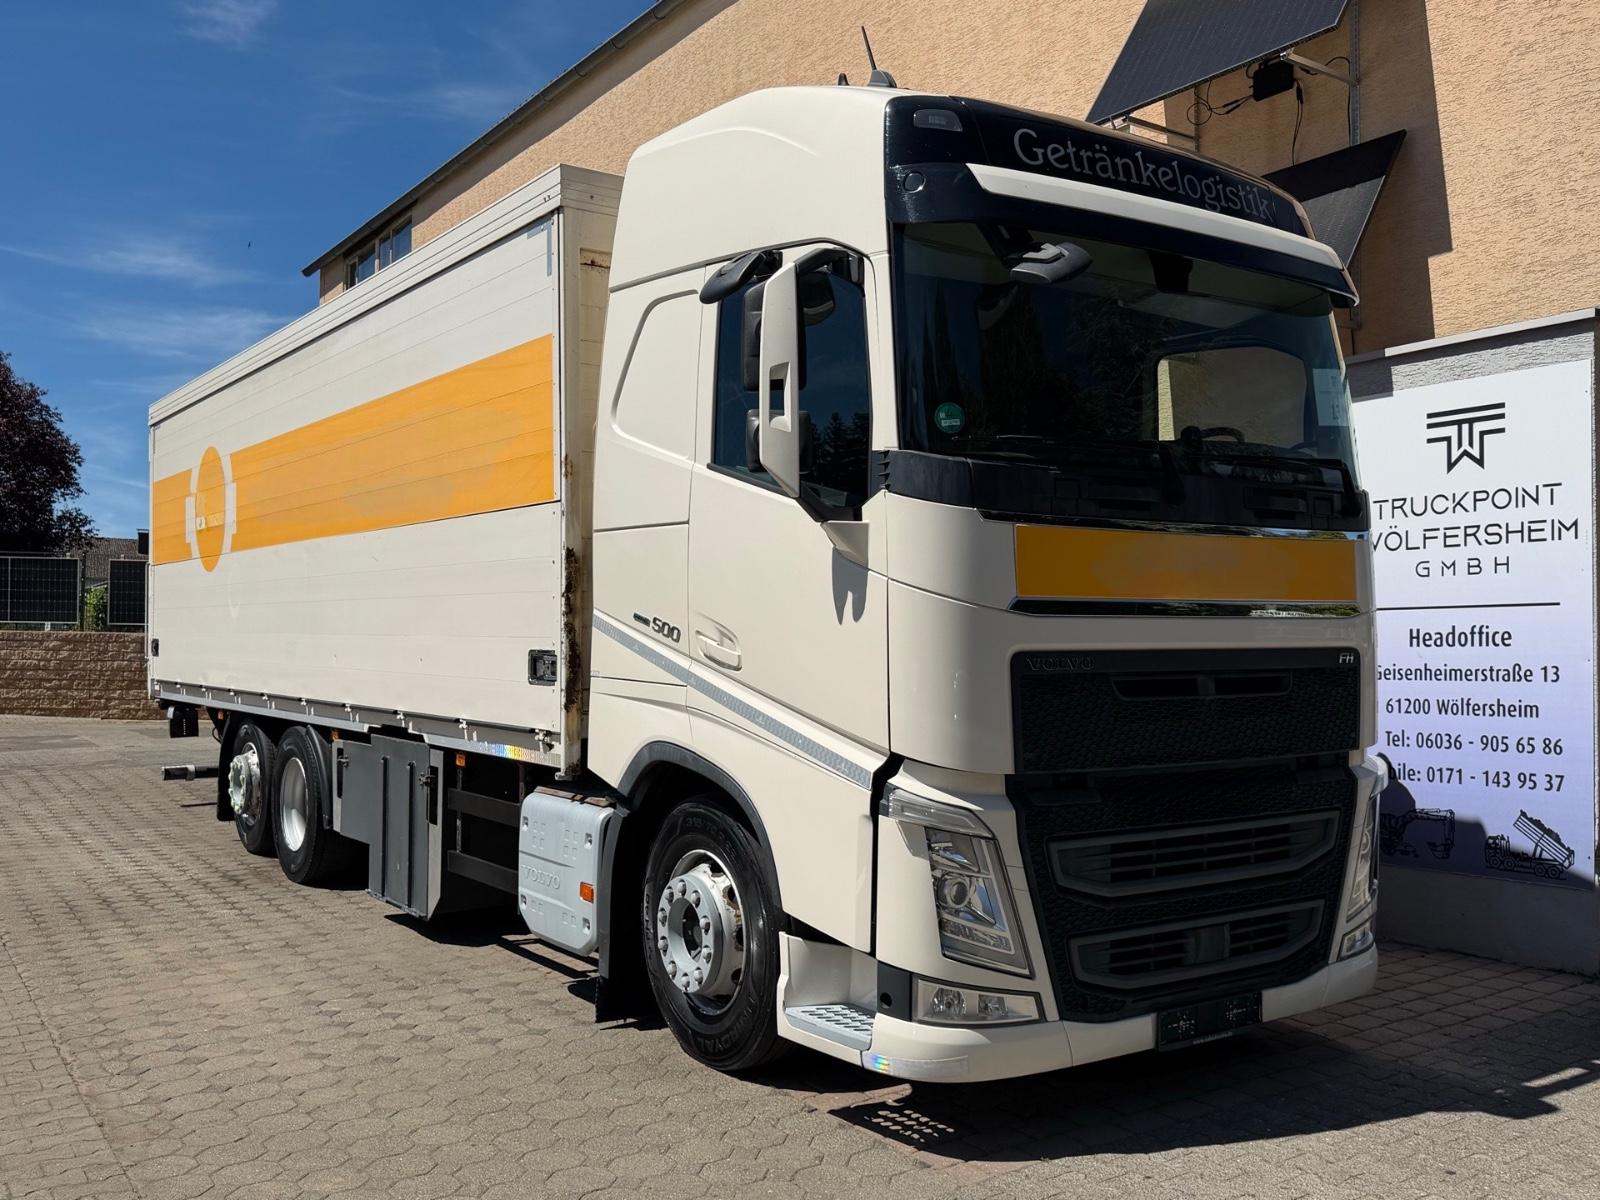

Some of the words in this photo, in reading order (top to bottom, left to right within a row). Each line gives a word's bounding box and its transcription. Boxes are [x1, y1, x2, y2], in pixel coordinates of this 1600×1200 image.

[1013, 128, 1274, 221] Getränkelogistik
[1372, 482, 1562, 520] TRUCKPOINT
[652, 616, 681, 643] 500
[1408, 625, 1513, 648] Headoffice
[1338, 652, 1354, 664] FH
[1540, 665, 1560, 683] 13
[1385, 697, 1431, 715] 61200
[1436, 698, 1540, 718] Wölfersheim
[1385, 730, 1411, 748] Tel:
[1415, 732, 1463, 750] 06036
[1480, 735, 1509, 753] 905
[1516, 737, 1536, 755] 65
[1542, 738, 1563, 756] 86
[1388, 763, 1421, 783] bile:
[1426, 766, 1463, 785] 0171
[1482, 770, 1511, 788] 143
[1517, 772, 1538, 790] 95
[1544, 774, 1565, 792] 37
